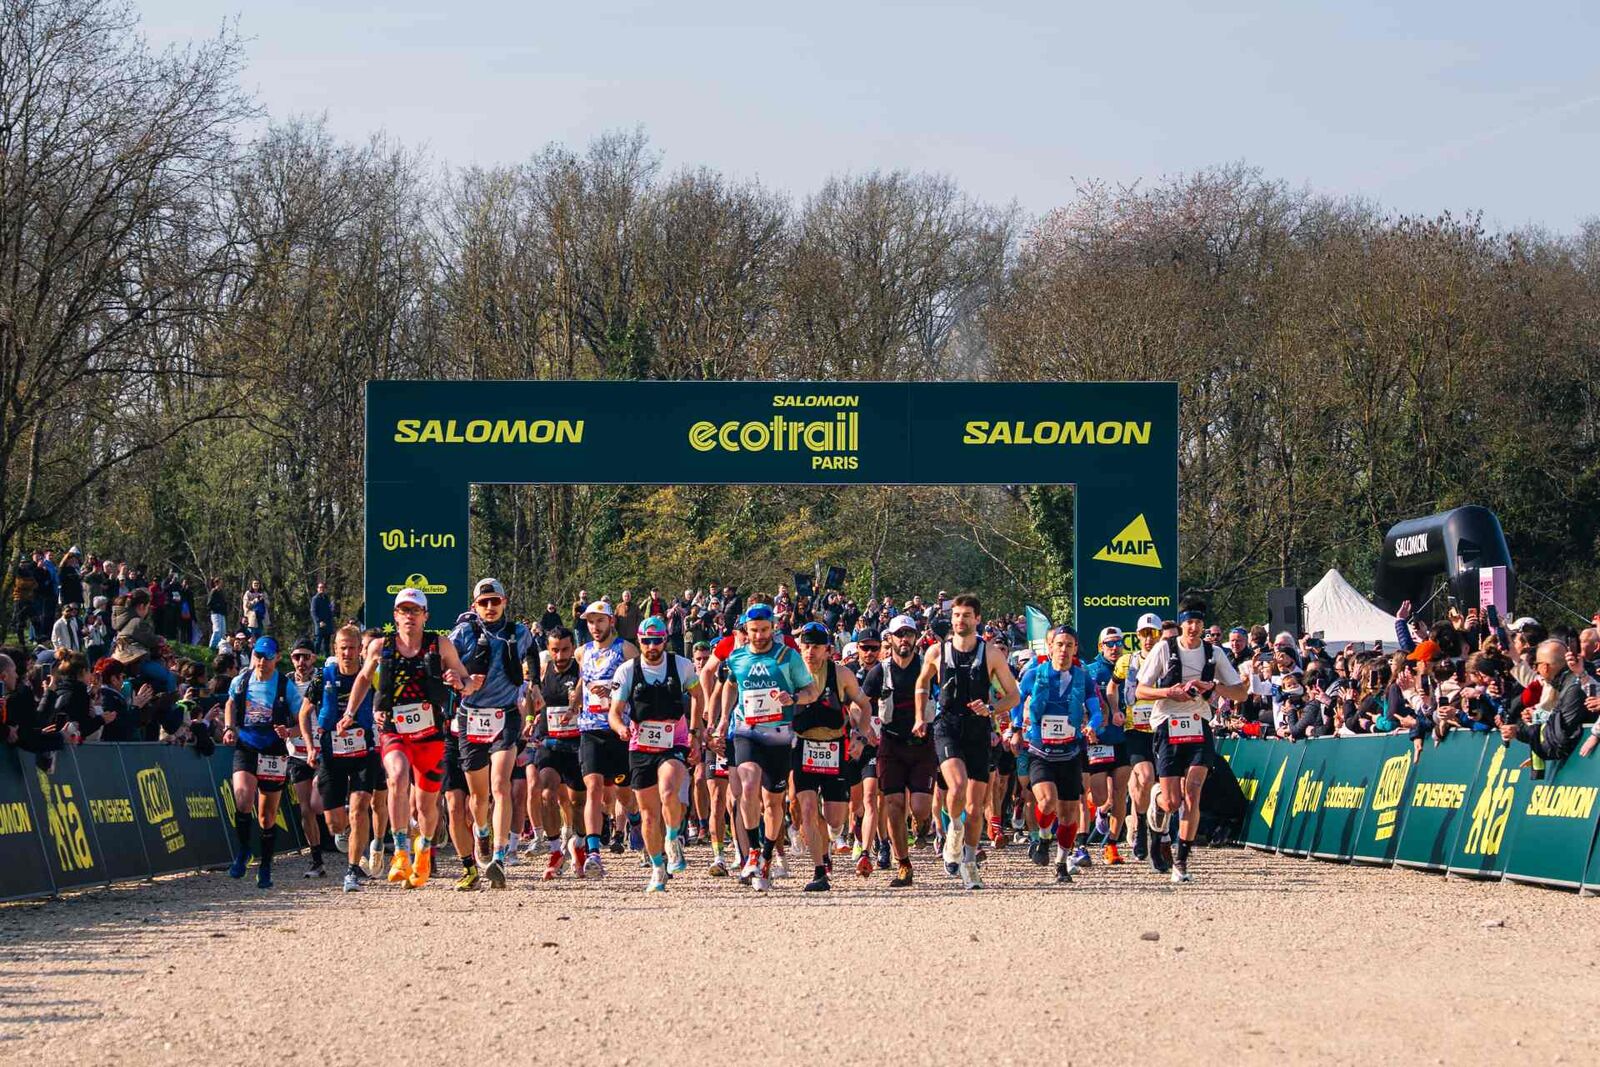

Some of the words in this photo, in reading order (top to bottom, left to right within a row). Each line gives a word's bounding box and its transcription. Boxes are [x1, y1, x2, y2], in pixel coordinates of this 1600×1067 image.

[773, 395, 858, 407] SALOMON
[394, 419, 584, 443] SALOMON
[689, 412, 858, 452] ecotrail
[963, 420, 1151, 445] SALOMON
[812, 456, 858, 469] PARIS
[410, 529, 455, 548] i-run
[1106, 540, 1154, 555] MAIF
[1395, 533, 1428, 557] SALOMON
[1083, 595, 1170, 607] sodastream
[757, 699, 764, 709] 7
[405, 713, 421, 725] 60
[479, 718, 491, 728] 14
[1180, 720, 1190, 729] 61
[1053, 723, 1063, 733] 21
[647, 730, 661, 740] 34
[343, 737, 354, 747] 16
[808, 749, 832, 760] 1358
[267, 760, 278, 770] 18
[1412, 783, 1467, 809] FINISHERS
[1526, 785, 1598, 819] SALOMON
